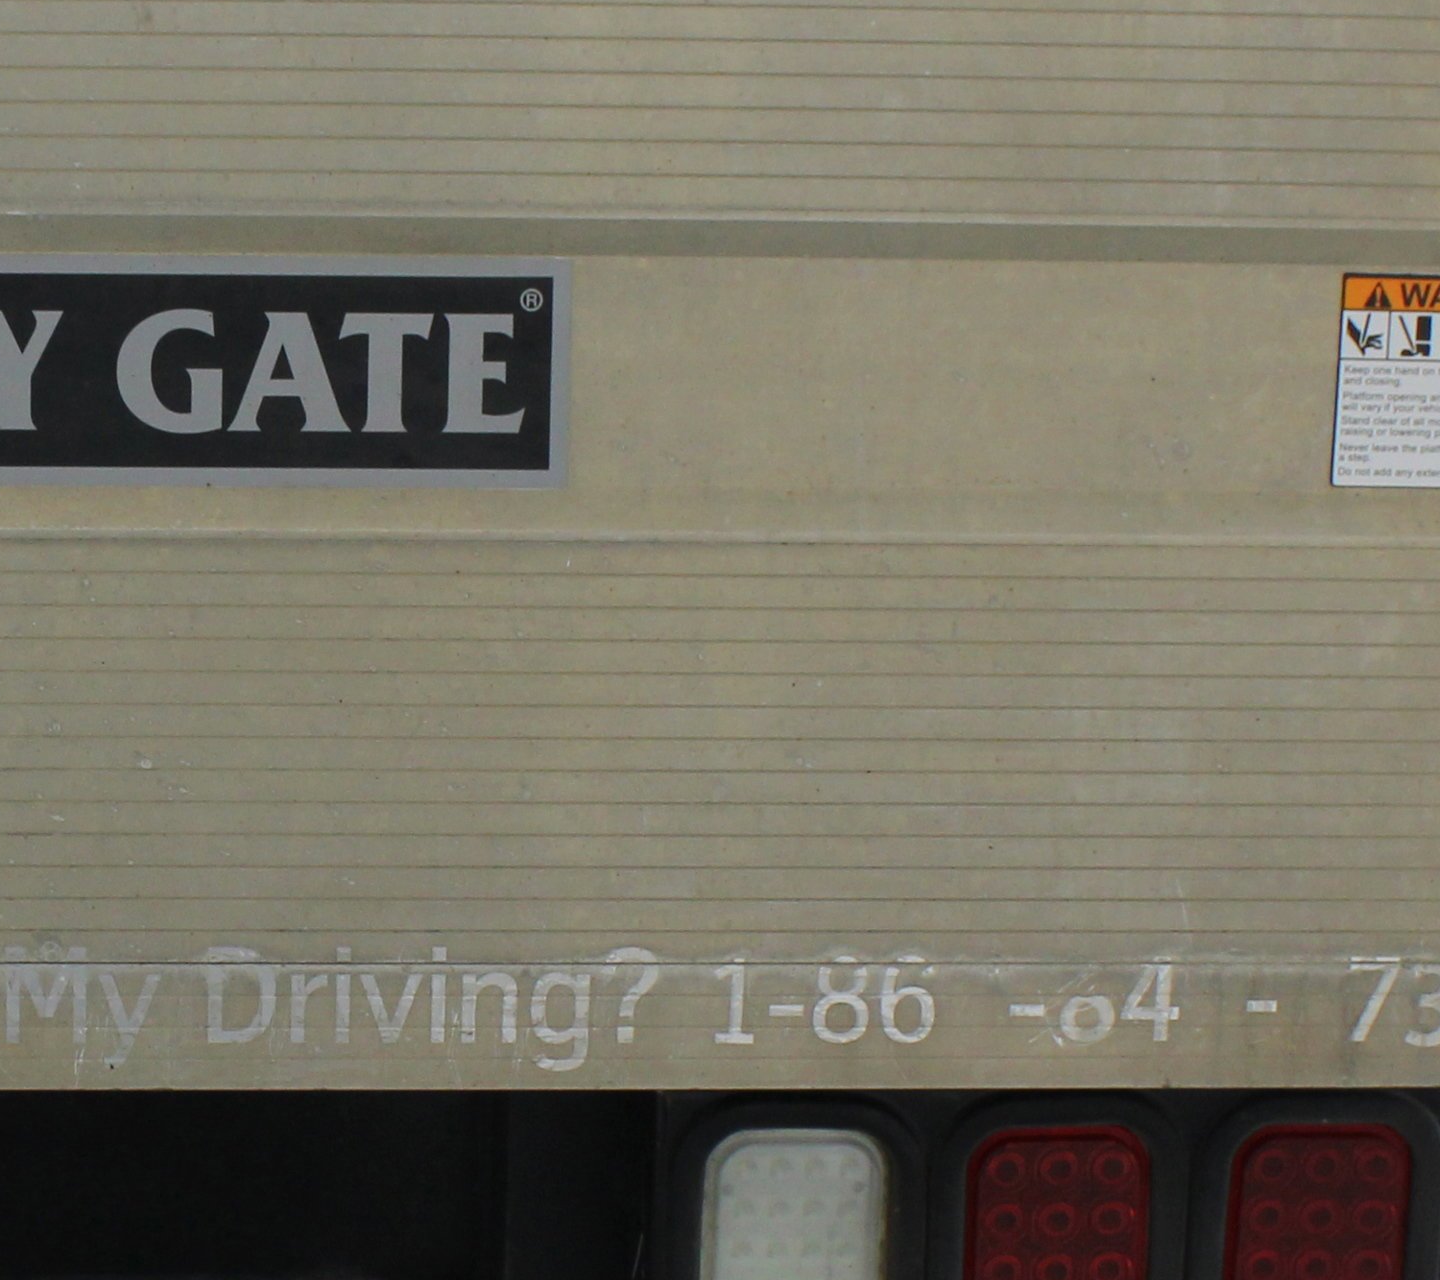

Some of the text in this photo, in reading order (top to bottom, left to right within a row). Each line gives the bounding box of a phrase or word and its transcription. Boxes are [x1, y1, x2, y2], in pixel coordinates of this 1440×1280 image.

[1344, 366, 1370, 376] Keep
[1373, 367, 1392, 375] one
[1394, 366, 1420, 375] hand
[1422, 368, 1436, 376] on
[1343, 391, 1385, 400] Platform
[1387, 393, 1427, 403] opening
[1342, 402, 1359, 410] will
[1360, 404, 1382, 414] vary
[1392, 405, 1415, 414] your
[1390, 428, 1432, 439] lowering
[1339, 443, 1370, 452] Never
[1372, 443, 1399, 452] leave
[1401, 443, 1417, 452] the
[1338, 466, 1352, 476] Do
[1354, 467, 1371, 476] not
[1373, 468, 1392, 476] add
[1394, 469, 1413, 478] any
[3, 945, 163, 1069] My
[206, 946, 660, 1072] Driving?
